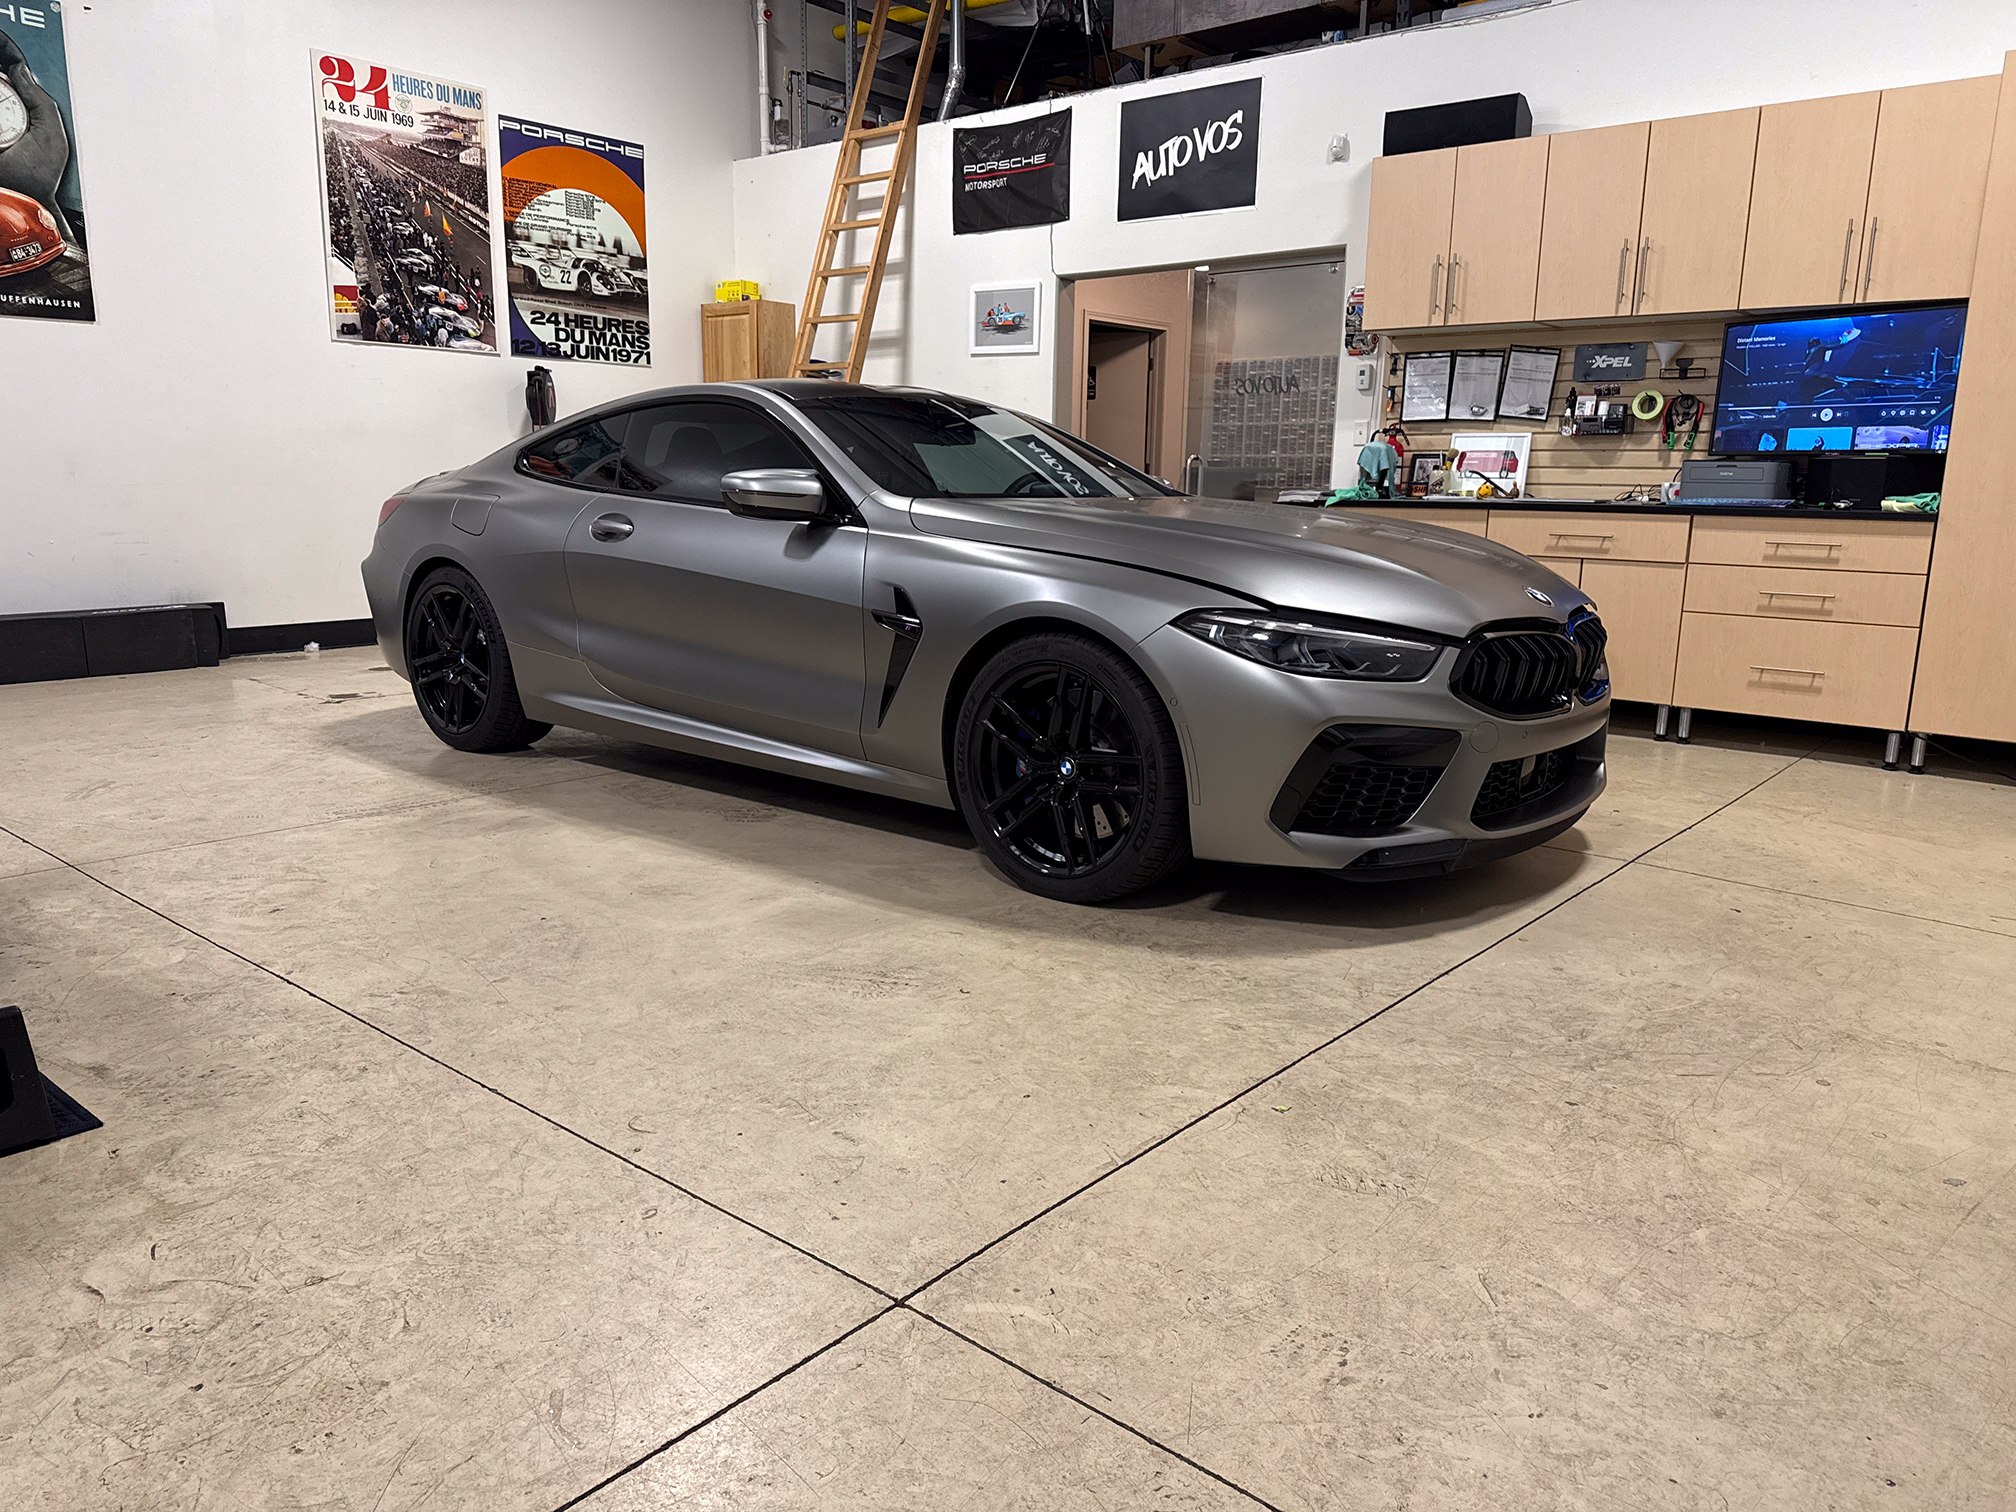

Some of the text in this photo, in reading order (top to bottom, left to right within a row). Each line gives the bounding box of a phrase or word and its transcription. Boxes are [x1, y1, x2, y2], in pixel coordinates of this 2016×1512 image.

[319, 55, 482, 112] 24 HEURES DU MANS
[323, 99, 414, 128] 14 & 15 JUIN 1969
[500, 119, 645, 160] PORSCHE
[1131, 109, 1244, 190] AUTO VOS
[963, 153, 1047, 174] PORSCHE
[964, 177, 1008, 192] MOTORSPORT
[560, 269, 572, 284] 22
[530, 310, 650, 336] 24 HEURES
[554, 327, 651, 351] DU MANS
[562, 343, 611, 362] JUIN
[610, 347, 651, 366] 1971
[1591, 354, 1633, 369] XPEL
